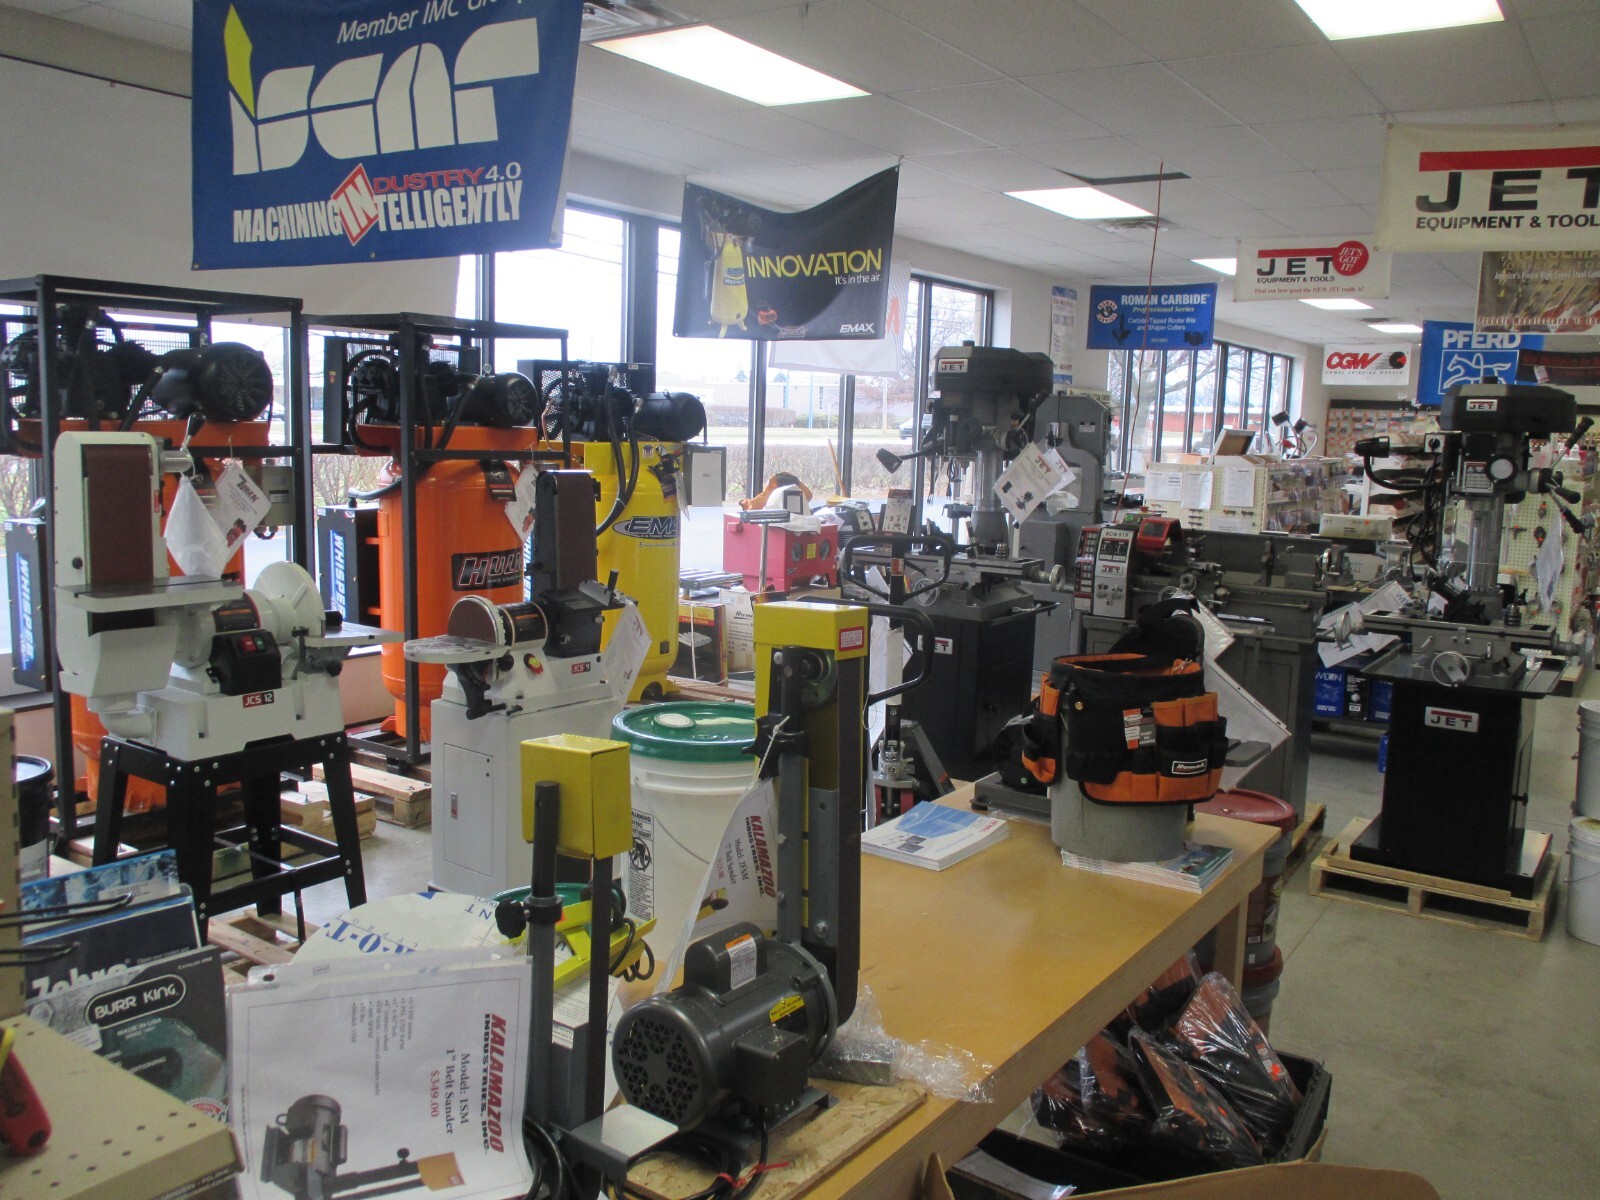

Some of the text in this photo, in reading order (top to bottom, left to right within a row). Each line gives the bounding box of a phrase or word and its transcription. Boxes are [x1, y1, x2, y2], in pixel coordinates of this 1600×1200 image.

[336, 0, 460, 44] Member IMC
[373, 161, 522, 194] DUSTRY 4.0
[1415, 168, 1600, 213] JET
[232, 201, 344, 243] MACHINING
[376, 180, 523, 233] TELLIGENTLY
[1415, 214, 1600, 230] EQUIPMENT & TOOL
[746, 248, 882, 278] INNOVATION
[1256, 257, 1334, 276] JET
[1339, 247, 1364, 272] JET'S GOT IT!
[834, 273, 882, 286] It's in the air.
[1309, 275, 1336, 283] TOOLS
[1121, 293, 1208, 306] ROMAN CARBIDE
[1175, 305, 1195, 313] Series
[840, 323, 875, 334] EMAX
[1147, 324, 1167, 332] Shaper
[1166, 323, 1186, 331] Cutters
[1442, 328, 1522, 350] PFERD
[940, 363, 966, 372] JET
[1326, 352, 1383, 370] CGW
[333, 534, 346, 619] WHISPER
[20, 558, 35, 660] WHISPER
[573, 663, 590, 673] JCS 9
[244, 693, 273, 706] JCS 12
[1430, 716, 1474, 729] JET
[749, 815, 777, 899] KALAMAZOO
[94, 983, 177, 1020] BURR KING
[146, 1017, 162, 1028] USA
[445, 1065, 456, 1089] Belt
[459, 1053, 471, 1125] Model: 1SM
[486, 1013, 508, 1154] KALAMAZOO
[429, 1069, 441, 1118] $349.00
[444, 1091, 456, 1136] Sander
[482, 1120, 491, 1156] INC.
